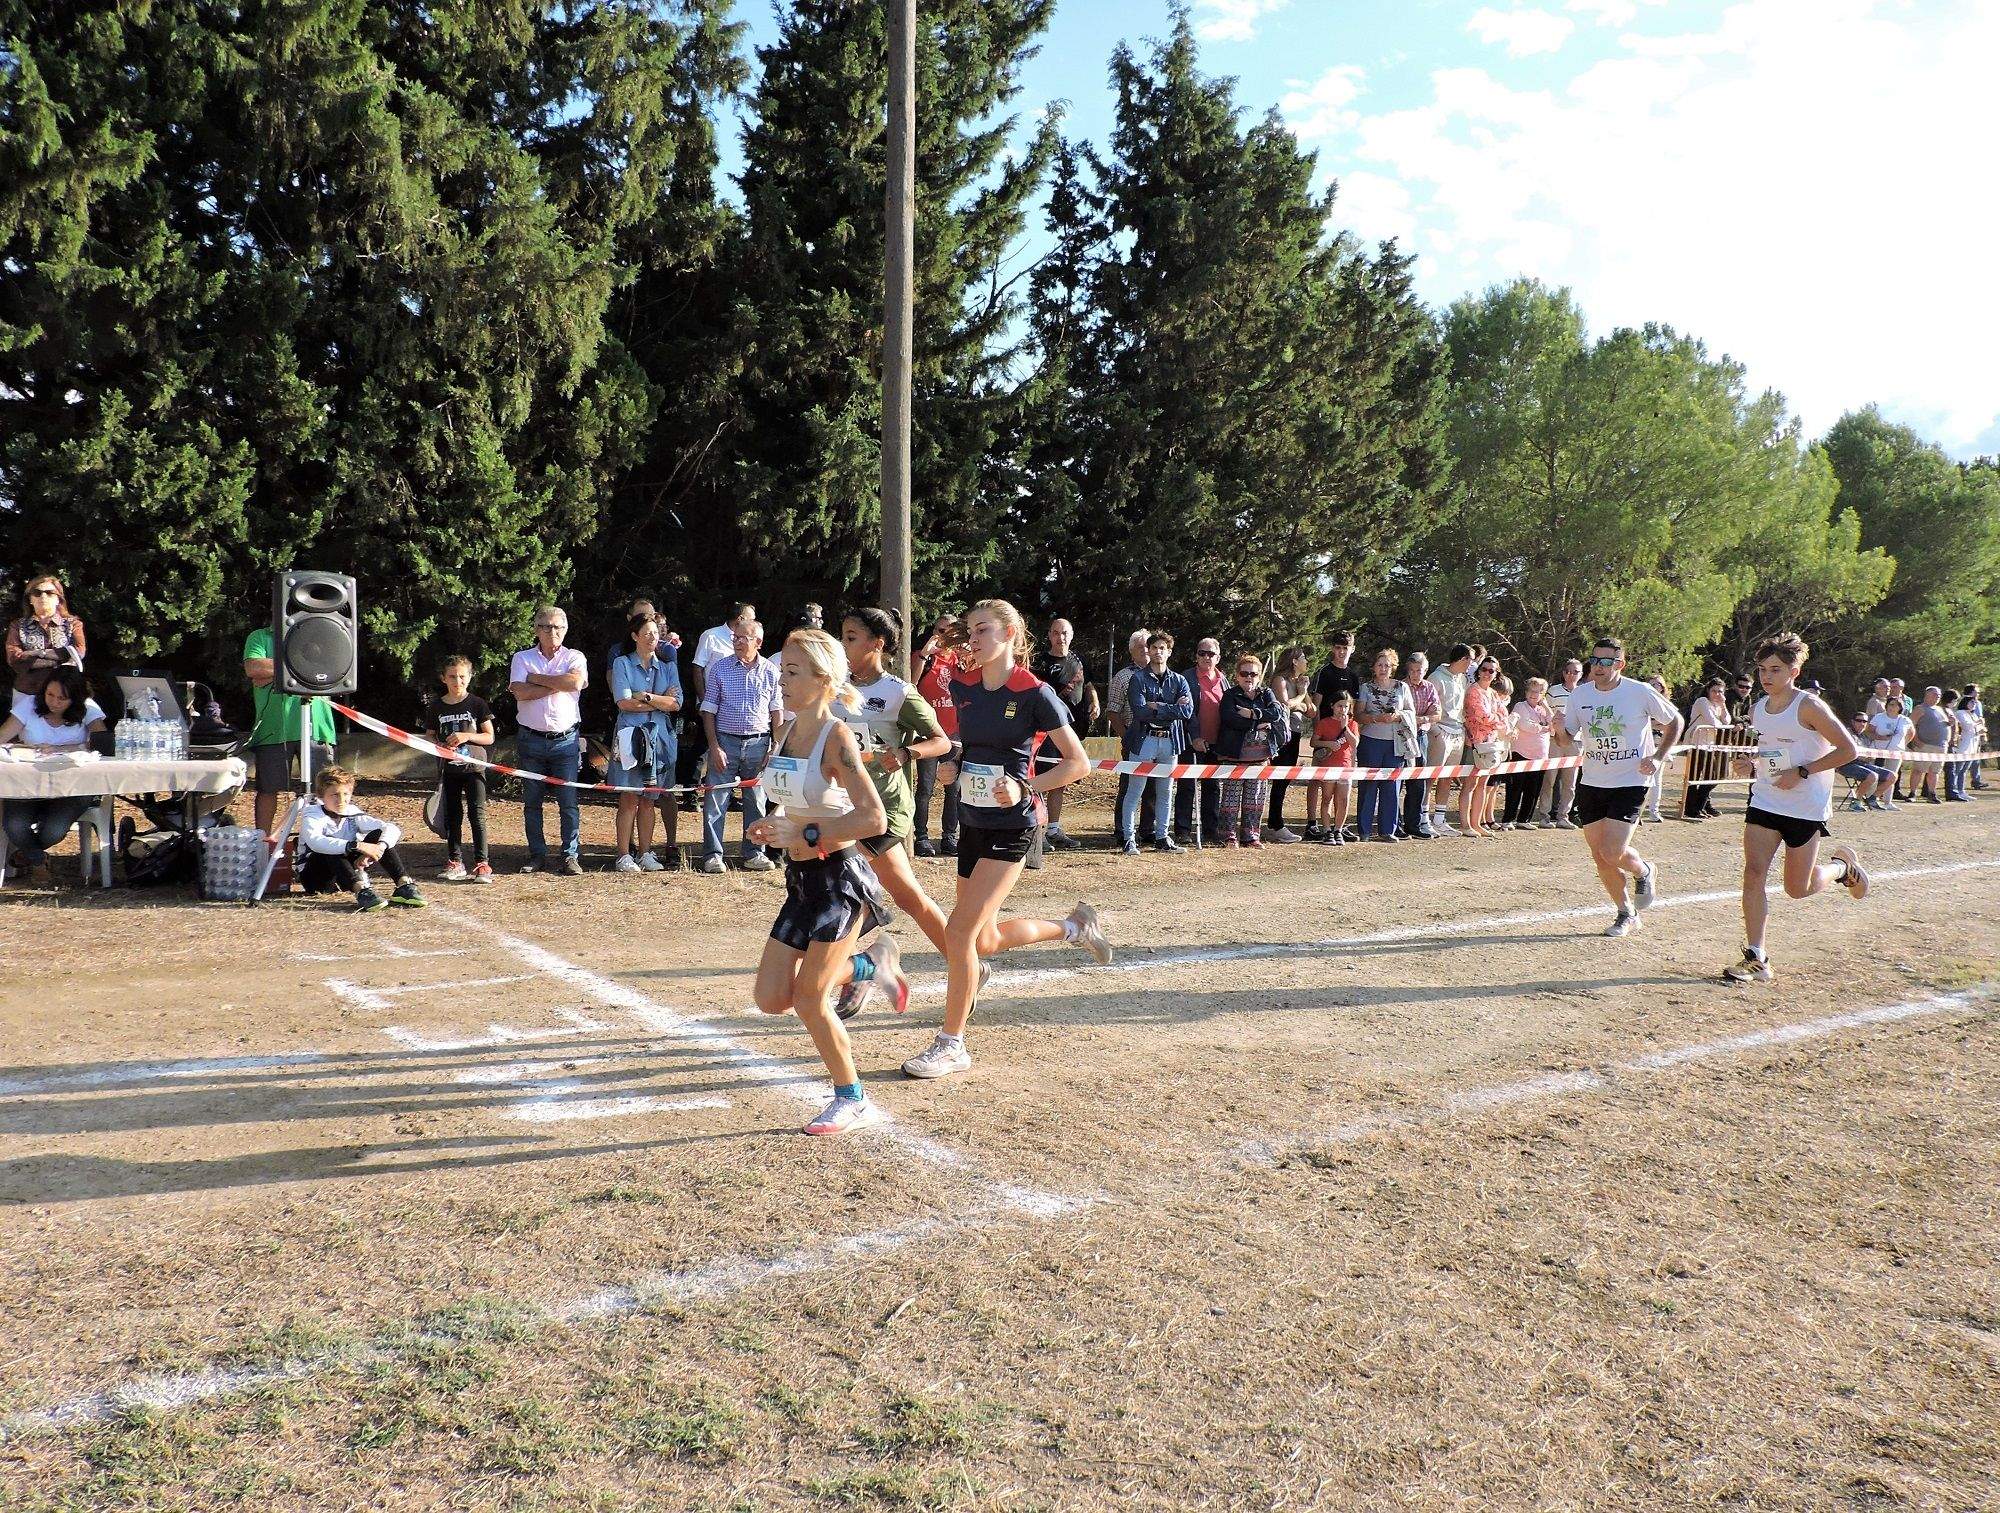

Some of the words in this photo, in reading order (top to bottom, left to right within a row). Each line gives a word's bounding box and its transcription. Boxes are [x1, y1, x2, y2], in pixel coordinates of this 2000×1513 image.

[1596, 705, 1613, 719] 14
[1596, 737, 1618, 750] 345
[1769, 758, 1776, 767] 6
[773, 771, 787, 787] 11
[970, 776, 986, 790] 13
